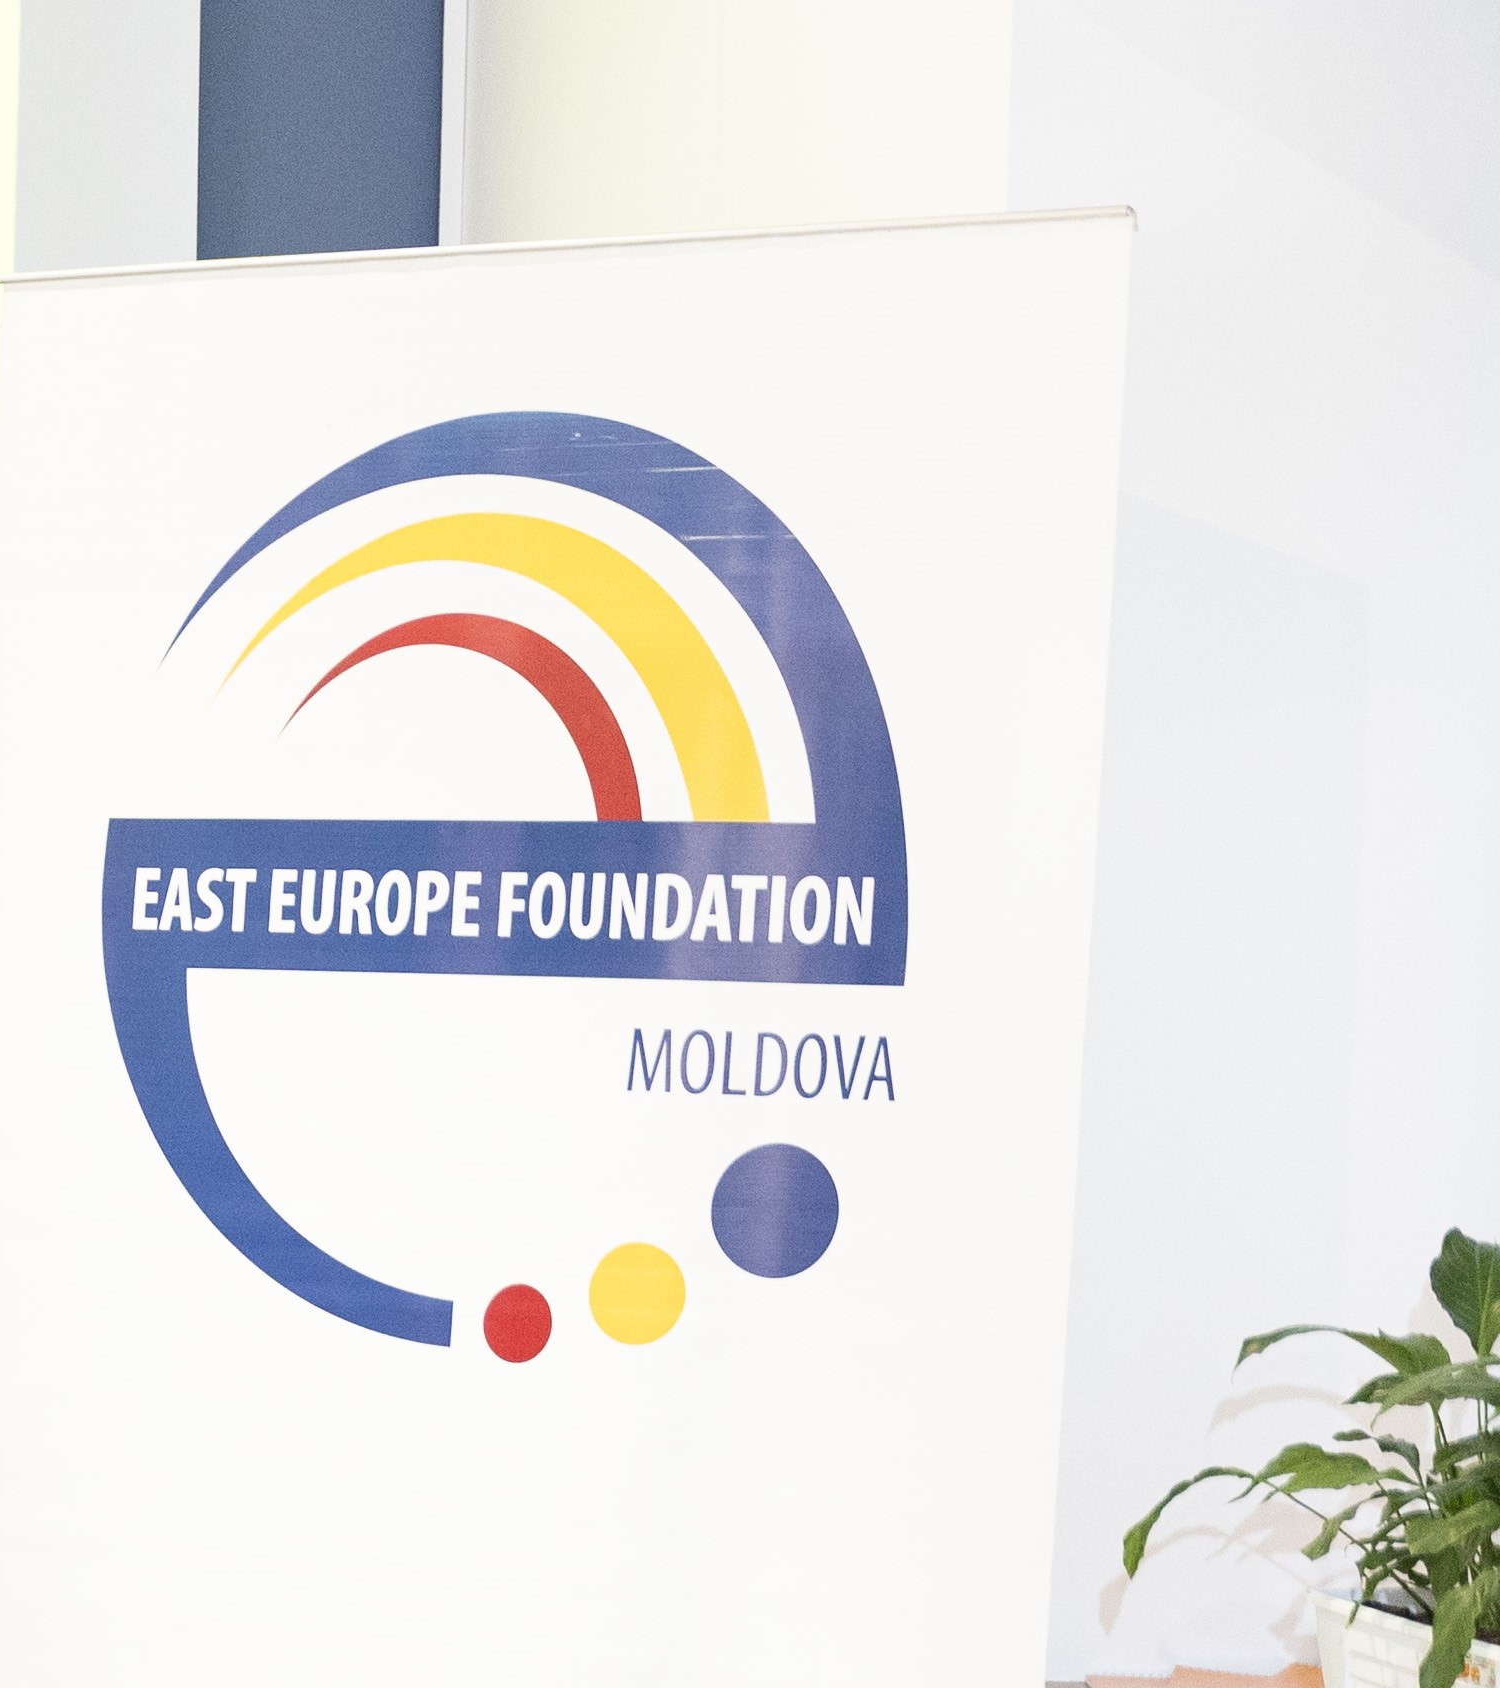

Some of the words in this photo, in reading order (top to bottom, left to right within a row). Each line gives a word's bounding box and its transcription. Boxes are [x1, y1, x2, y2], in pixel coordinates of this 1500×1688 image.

[132, 867, 257, 932] EAST
[267, 868, 482, 938] EUROPE
[499, 870, 876, 947] FOUNDATION
[627, 1027, 897, 1102] MOLDOVA
